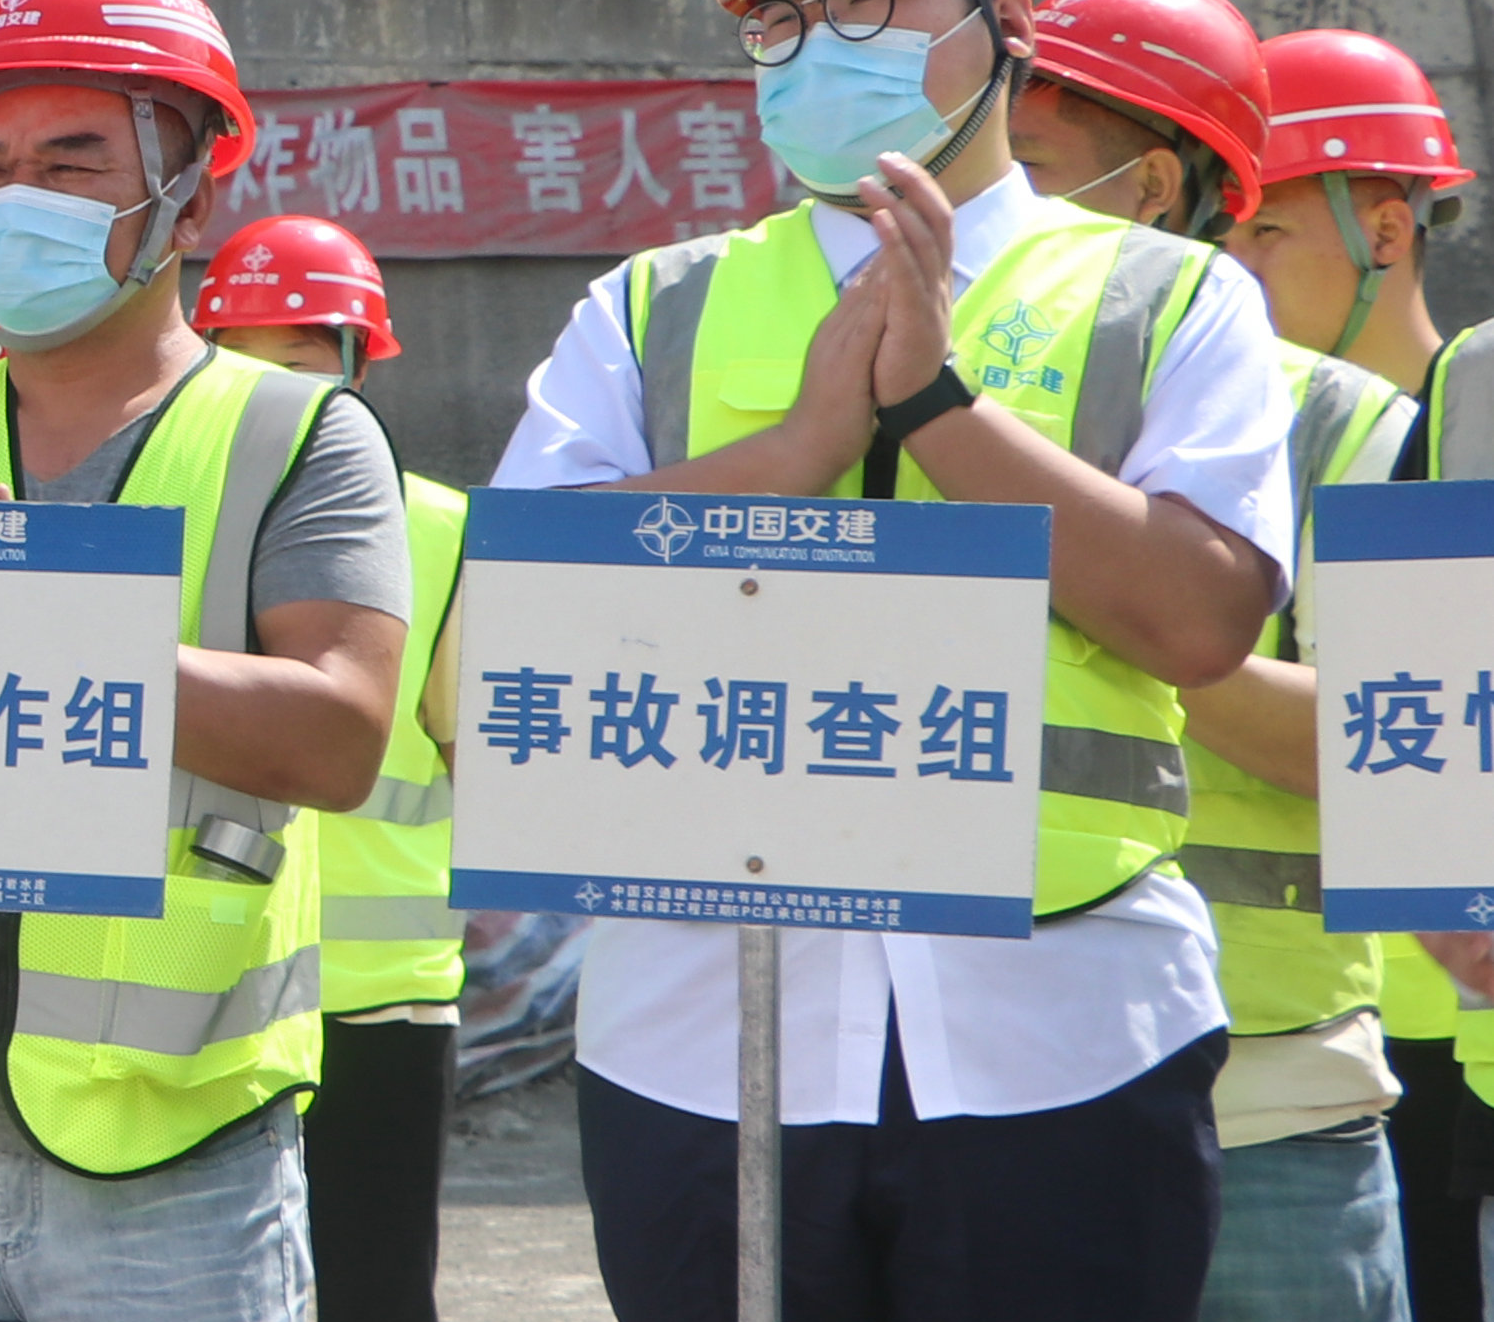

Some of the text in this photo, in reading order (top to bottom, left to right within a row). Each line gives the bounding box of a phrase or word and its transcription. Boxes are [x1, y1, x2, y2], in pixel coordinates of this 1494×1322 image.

[511, 100, 808, 214] 害人害
[704, 505, 876, 545] 中国交建
[478, 666, 1014, 783] 事故调查组
